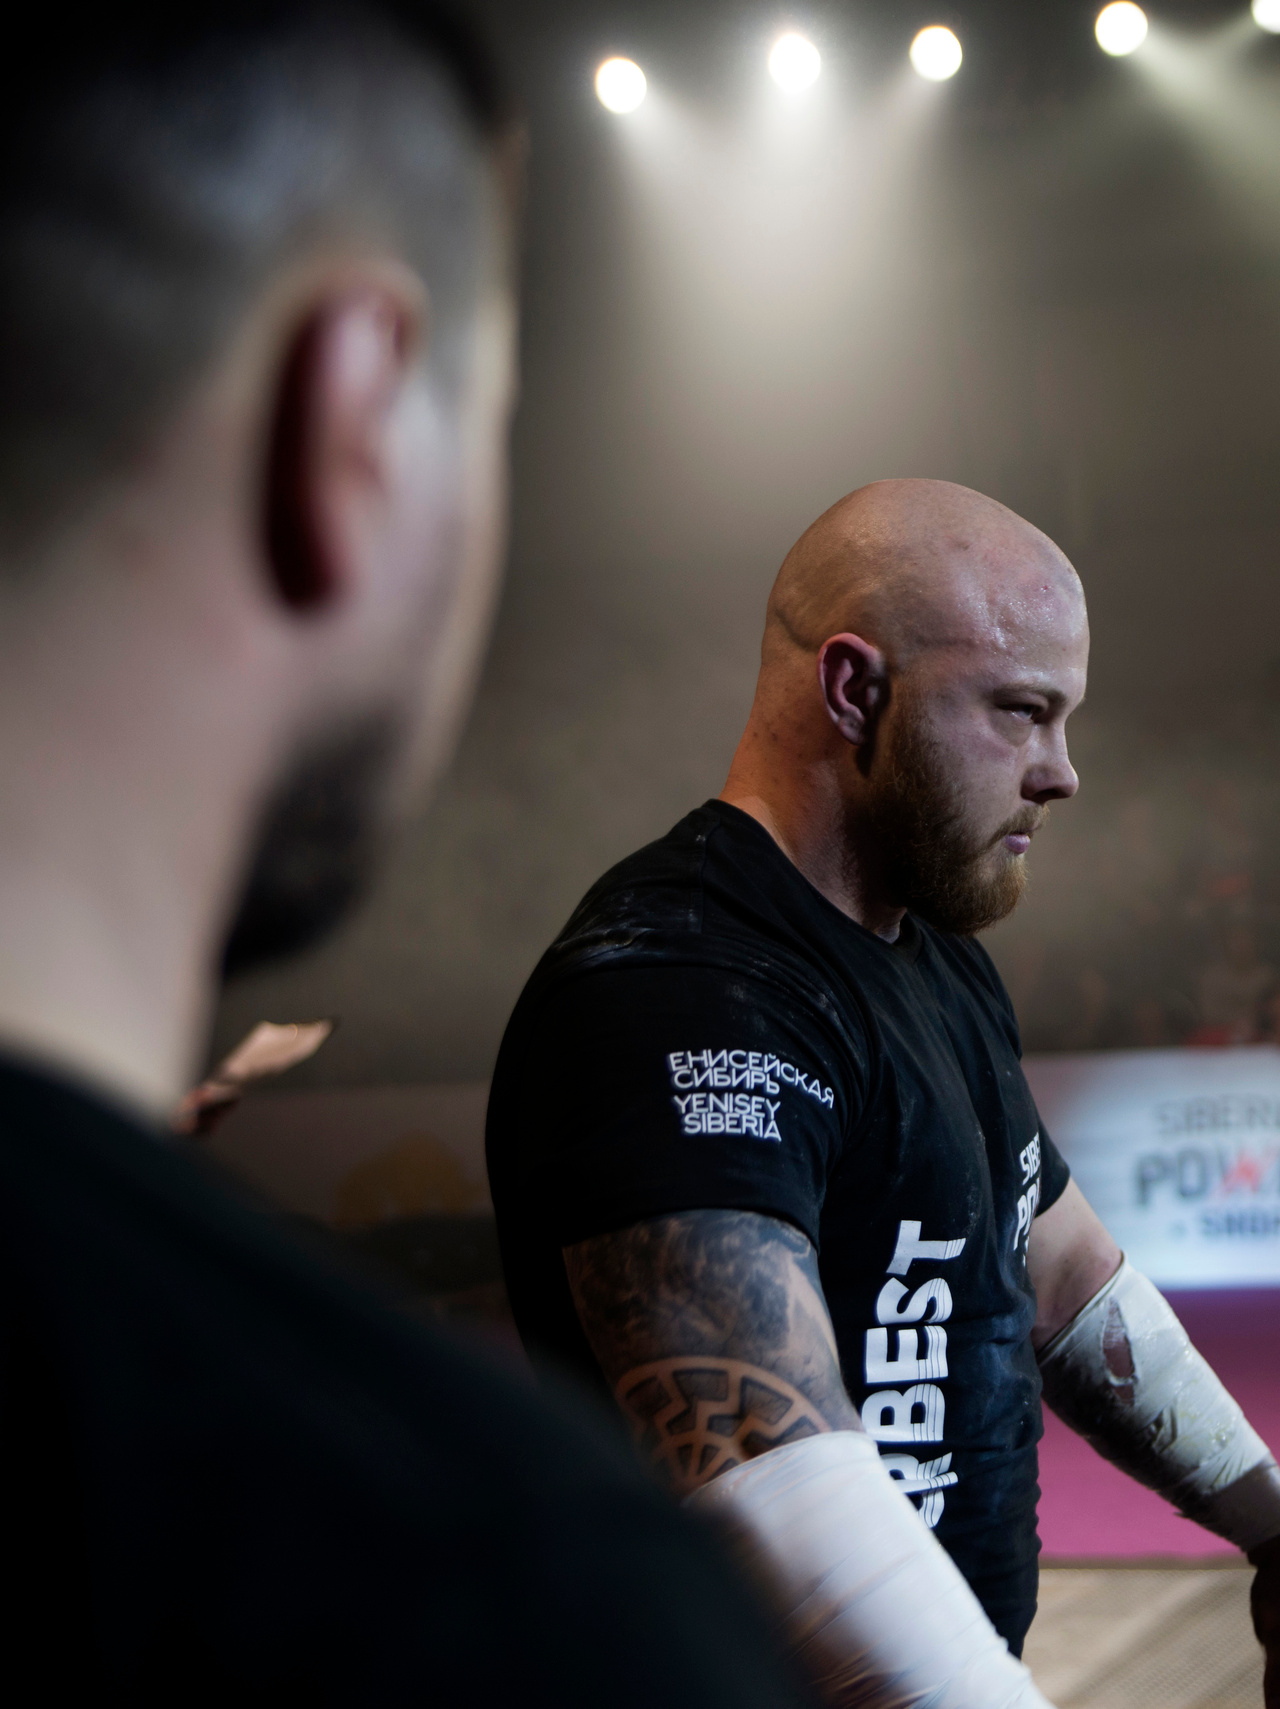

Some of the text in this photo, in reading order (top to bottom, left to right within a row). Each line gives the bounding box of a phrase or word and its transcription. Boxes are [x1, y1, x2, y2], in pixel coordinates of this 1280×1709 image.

[668, 1049, 835, 1109] ЕНИСЕЙСКАЯ
[673, 1067, 780, 1095] СИБИРЬ
[673, 1093, 781, 1119] YENISEY
[684, 1112, 782, 1142] SIBERIA
